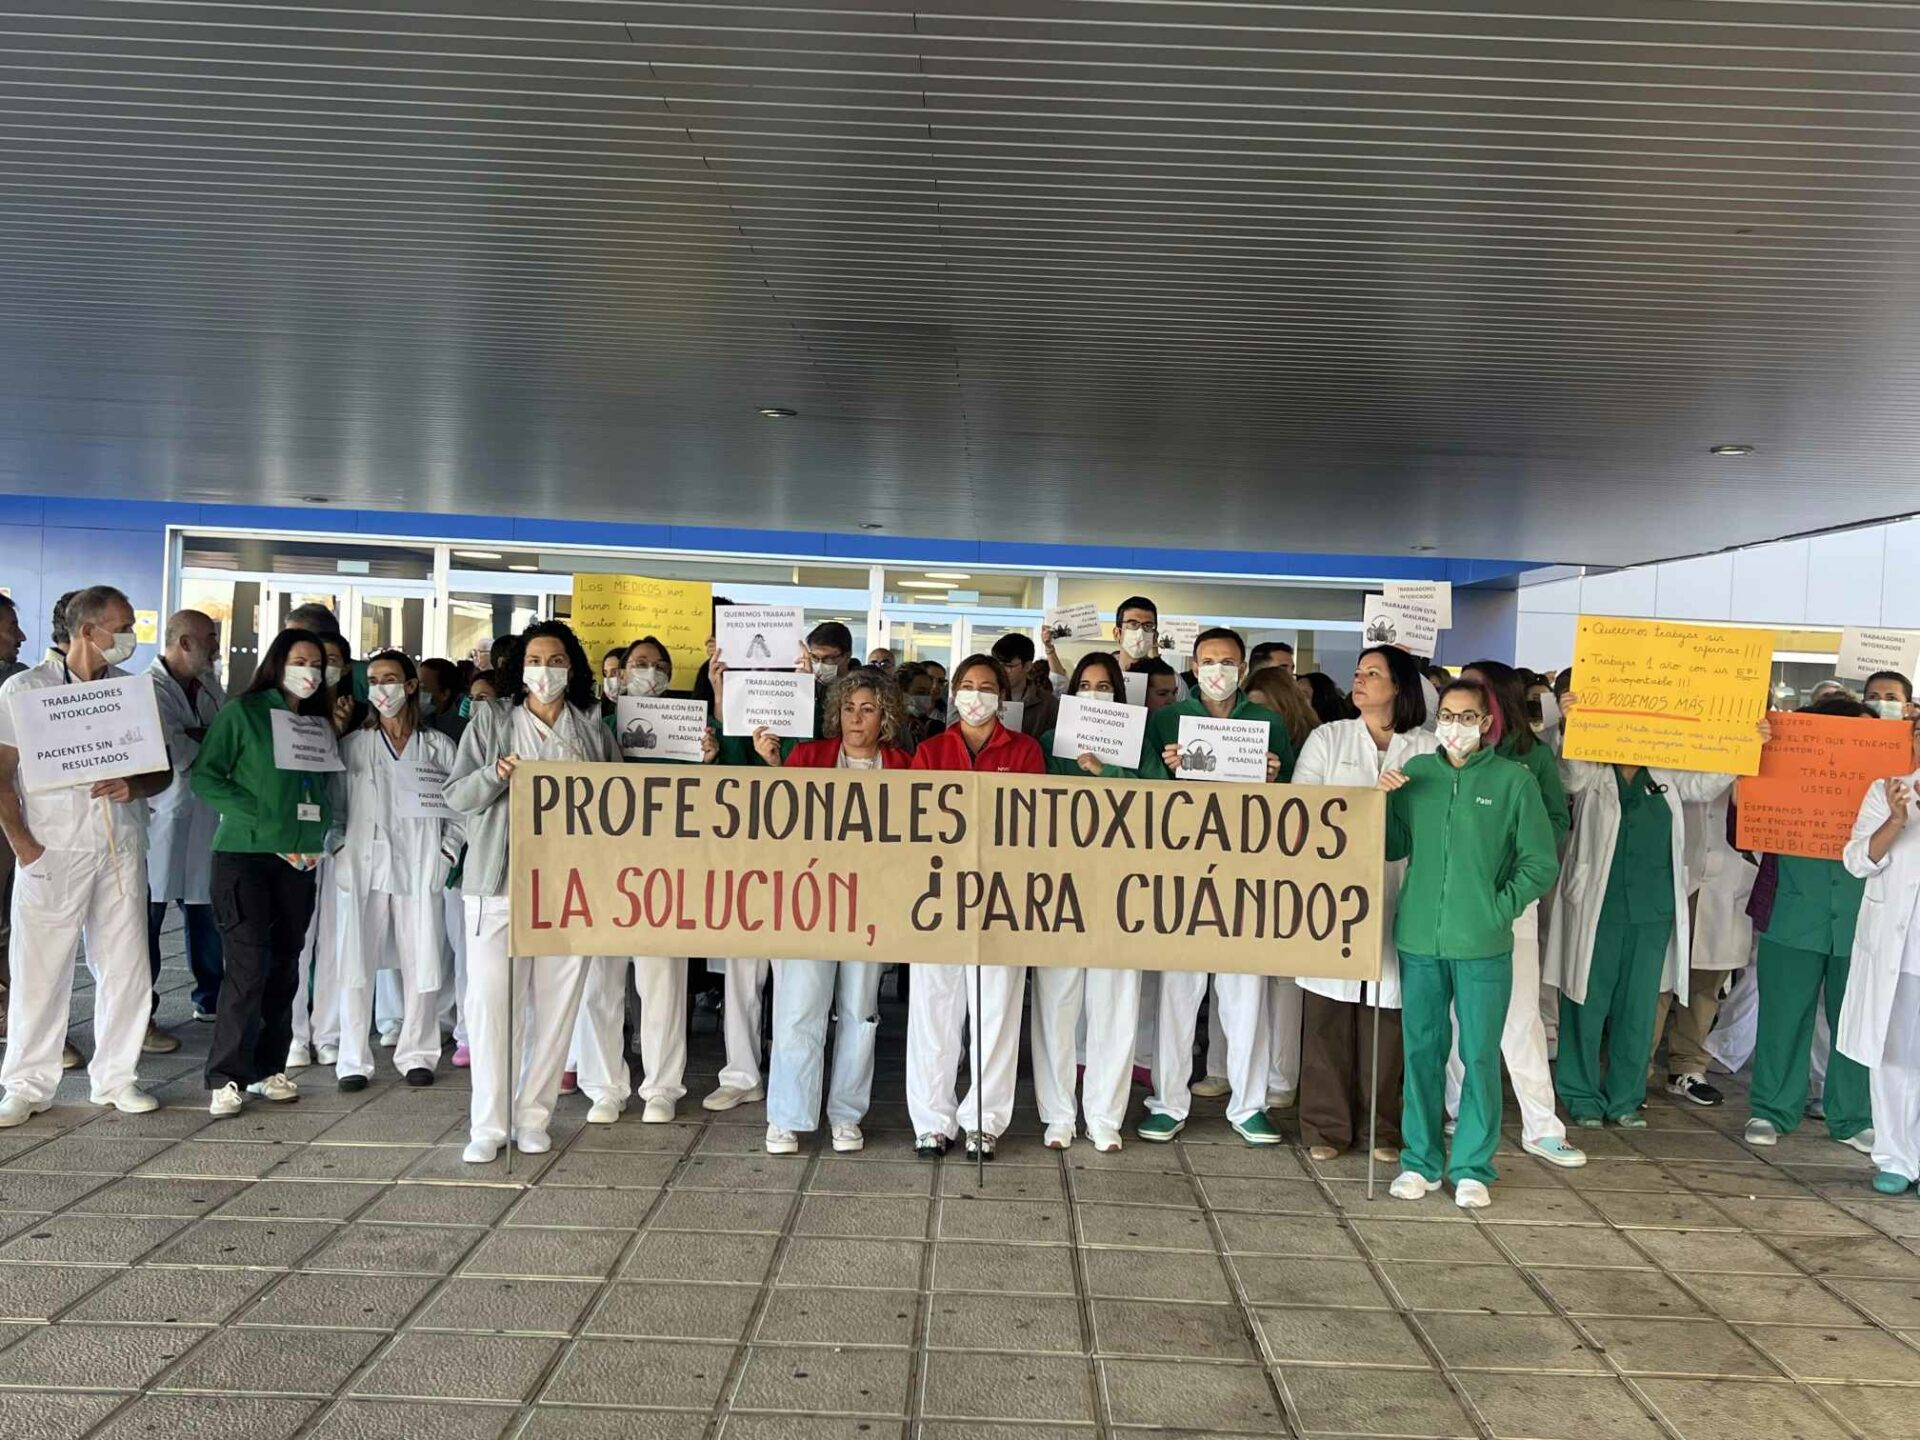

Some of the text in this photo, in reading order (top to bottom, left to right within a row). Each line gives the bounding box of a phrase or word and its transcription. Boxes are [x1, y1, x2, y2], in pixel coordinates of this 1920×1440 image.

[580, 578, 603, 592] Los
[723, 611, 761, 619] QUEREMOS
[726, 621, 794, 629] PERO SIN ENFERMAR
[1592, 621, 1648, 637] Queremos
[1654, 624, 1699, 649] trabajar
[745, 679, 798, 688] TRABAJADORES
[41, 687, 123, 708] TRABAJADORES
[747, 689, 795, 698] INTOXICADOS
[636, 702, 670, 711] TRABAJAR
[1580, 692, 1601, 706] NO
[1607, 691, 1669, 712] PODEMOS
[49, 703, 122, 722] INTOXICADOS
[661, 713, 703, 722] MASCARILLA
[746, 707, 795, 717] PACIENTES SIN
[1079, 704, 1130, 719] TRABAJADORES
[748, 718, 792, 727] RESULTADOS
[1080, 715, 1125, 729] INTOXICADOS
[1196, 723, 1231, 732] TRABAJAR
[687, 725, 703, 733] UNA
[668, 734, 703, 742] PESADILLA
[1076, 733, 1124, 747] PACIENTES SIN
[1221, 735, 1264, 744] MASCARILLA
[1824, 736, 1845, 746] QUE
[1852, 738, 1902, 751] TENEMOS
[37, 739, 114, 761] PACIENTES SIN
[1078, 743, 1119, 755] RESULTADOS
[61, 751, 130, 772] RESULTADOS
[1227, 756, 1263, 765] PESADILLA
[1800, 767, 1866, 781] TRABAJE
[1801, 785, 1842, 796] USTED
[1743, 801, 1803, 815] ESPERAMOS
[532, 774, 1349, 860] PROFESIONALES INTOXICADOS
[1743, 826, 1780, 836] DENTRO
[530, 854, 1370, 959] LA SOLUCIÓN, ¿PARA CUÁNDO?
